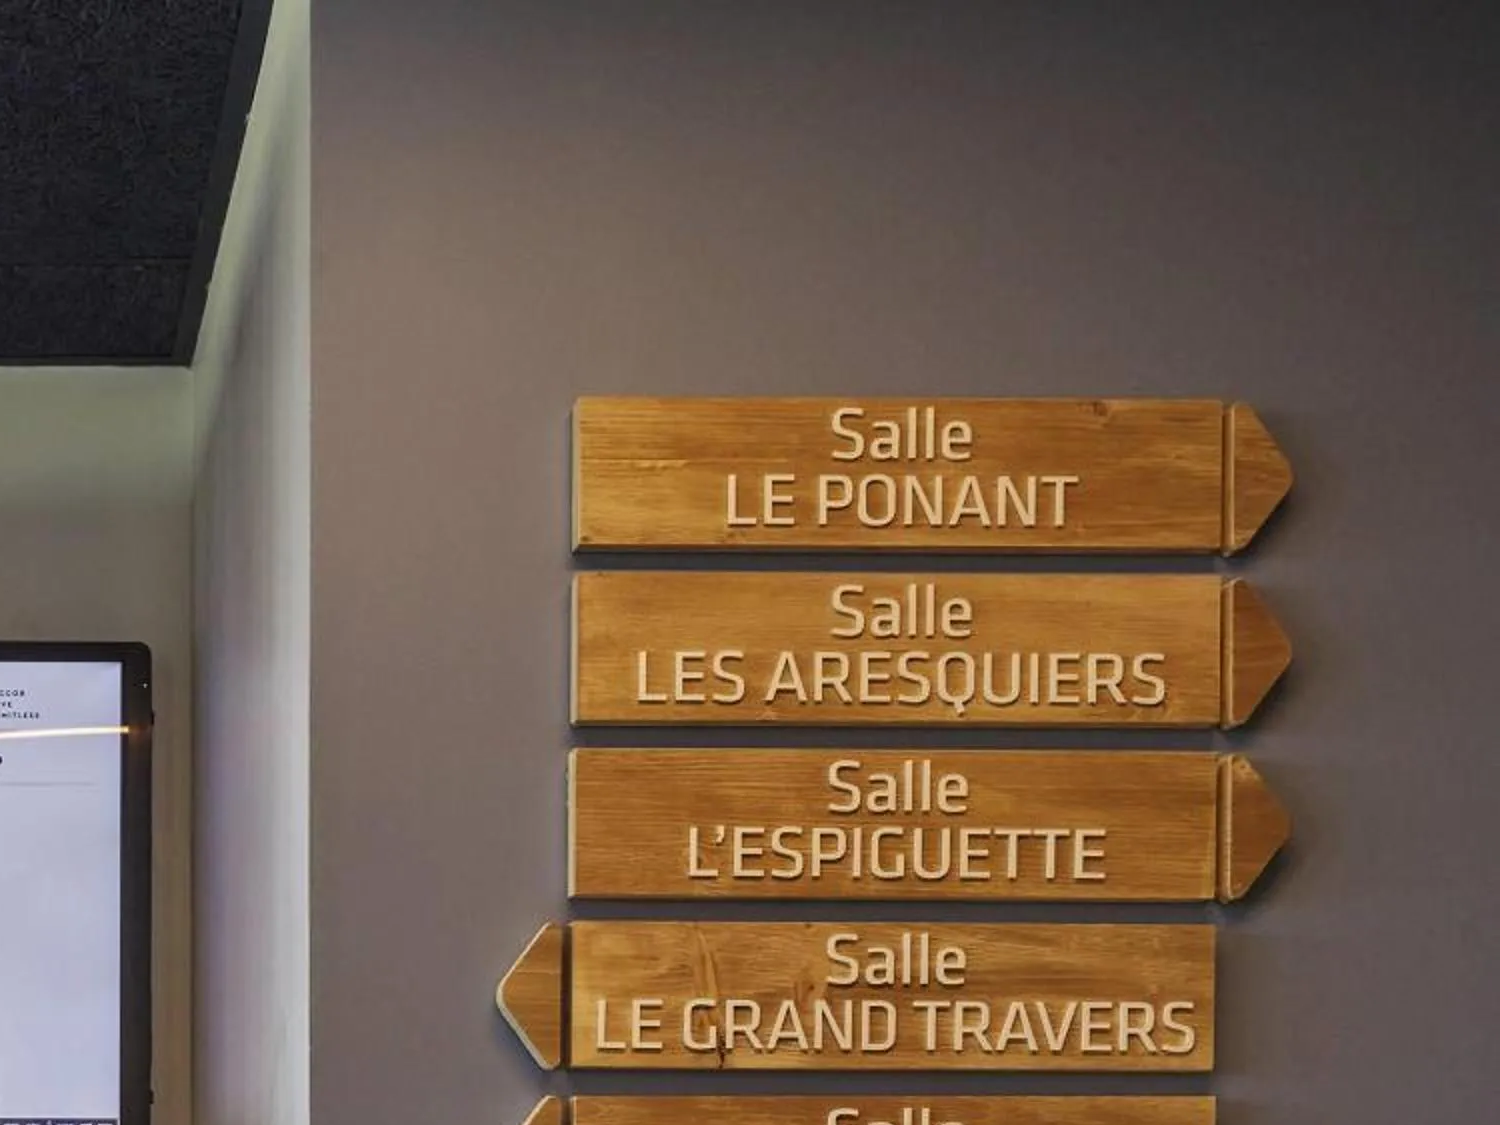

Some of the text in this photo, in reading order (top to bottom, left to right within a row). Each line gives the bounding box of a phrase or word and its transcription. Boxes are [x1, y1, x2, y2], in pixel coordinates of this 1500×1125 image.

[831, 407, 973, 461] Salle
[725, 473, 1079, 529] LE PONANT
[831, 583, 973, 638] Salle
[636, 650, 1167, 717] LES ARESQUIERS
[828, 759, 970, 814] Salle
[687, 824, 1108, 881] L'ESPIGUETTE
[826, 933, 968, 987] Salle
[595, 998, 1196, 1054] LE GRAND TRAVERS
